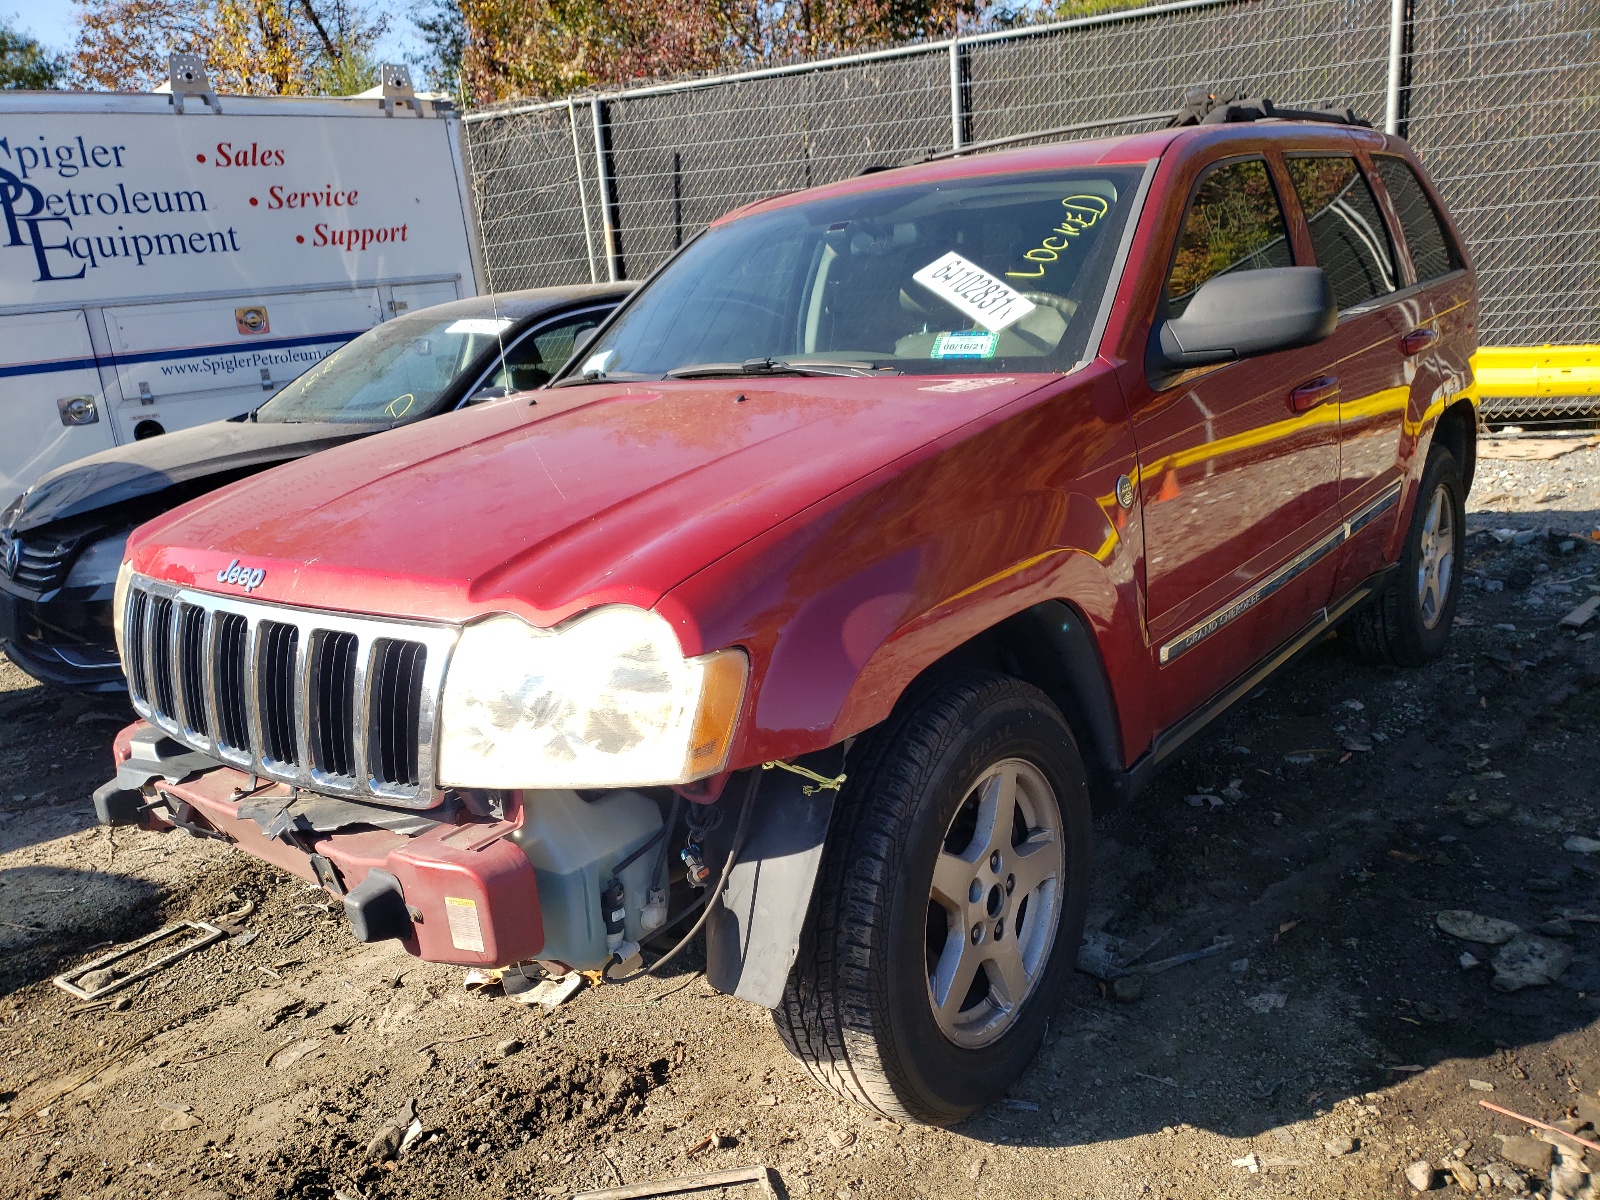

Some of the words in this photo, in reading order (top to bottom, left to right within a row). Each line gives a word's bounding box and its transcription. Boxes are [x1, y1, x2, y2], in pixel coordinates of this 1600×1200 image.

[215, 141, 285, 168] Sales
[268, 184, 359, 210] Service
[0, 182, 208, 247] Petroleum
[17, 216, 241, 282] Equipment
[313, 222, 408, 251] Support
[1005, 195, 1108, 278] LOCKED
[161, 349, 337, 376] www.SpiglerPetroleum.c
[216, 559, 266, 593] Jeep
[1186, 620, 1218, 646] GRAND
[1220, 594, 1261, 625] CHEROKEE
